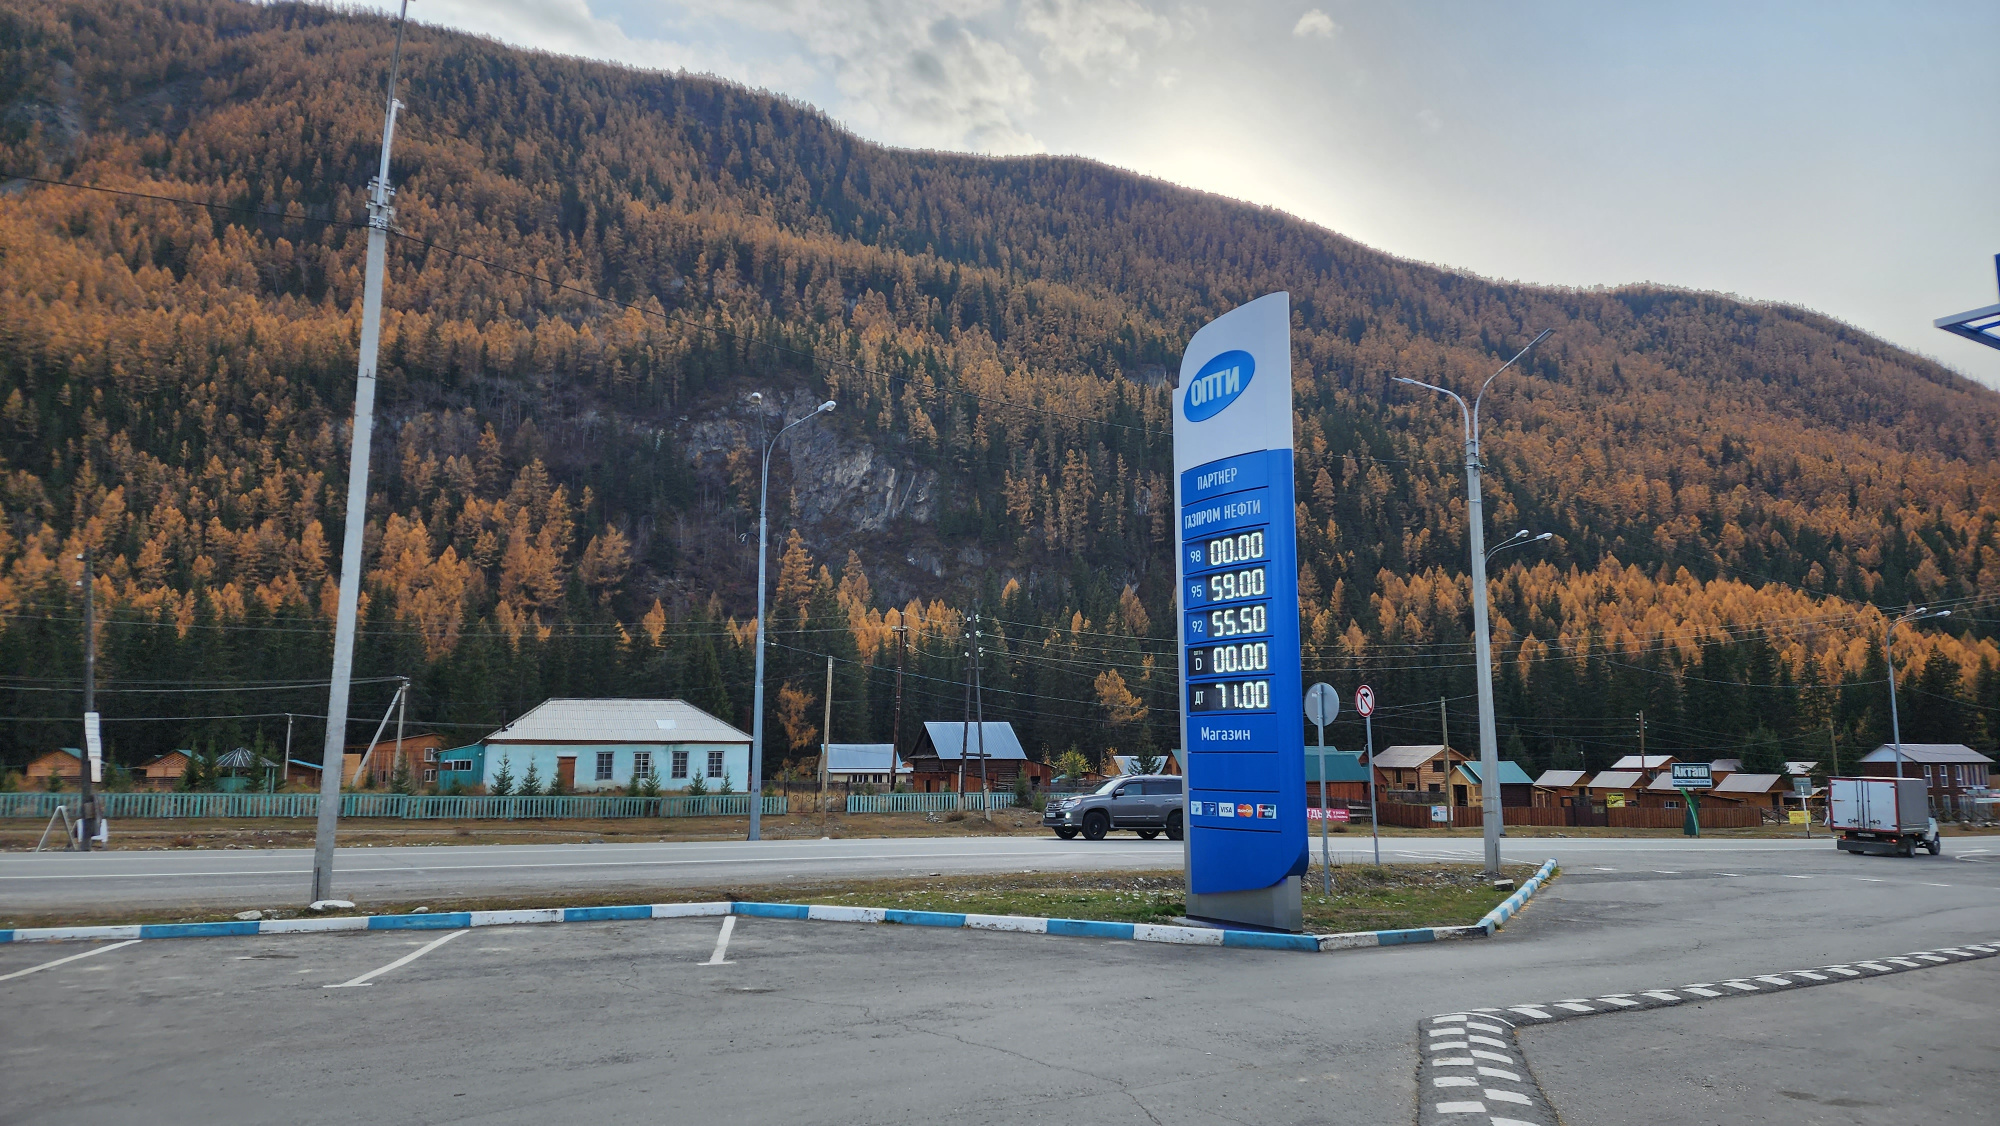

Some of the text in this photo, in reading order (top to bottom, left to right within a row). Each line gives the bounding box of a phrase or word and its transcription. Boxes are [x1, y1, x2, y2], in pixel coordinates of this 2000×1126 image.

[1191, 366, 1240, 406] ОПТИ
[1197, 467, 1238, 490] ПАРТНЕР
[1184, 499, 1261, 529] ГАЗПРОМ НЕФТИ
[1190, 532, 1264, 565] 98 00.00
[1191, 568, 1265, 602] 95 59.00
[1192, 605, 1266, 637] 92 55.50
[1195, 642, 1267, 673] D 00.00
[1194, 681, 1268, 708] ДТ 71.00
[1201, 727, 1251, 741] Магазин
[1673, 765, 1709, 777] Акташ
[1307, 809, 1332, 820] ТДЫХ
